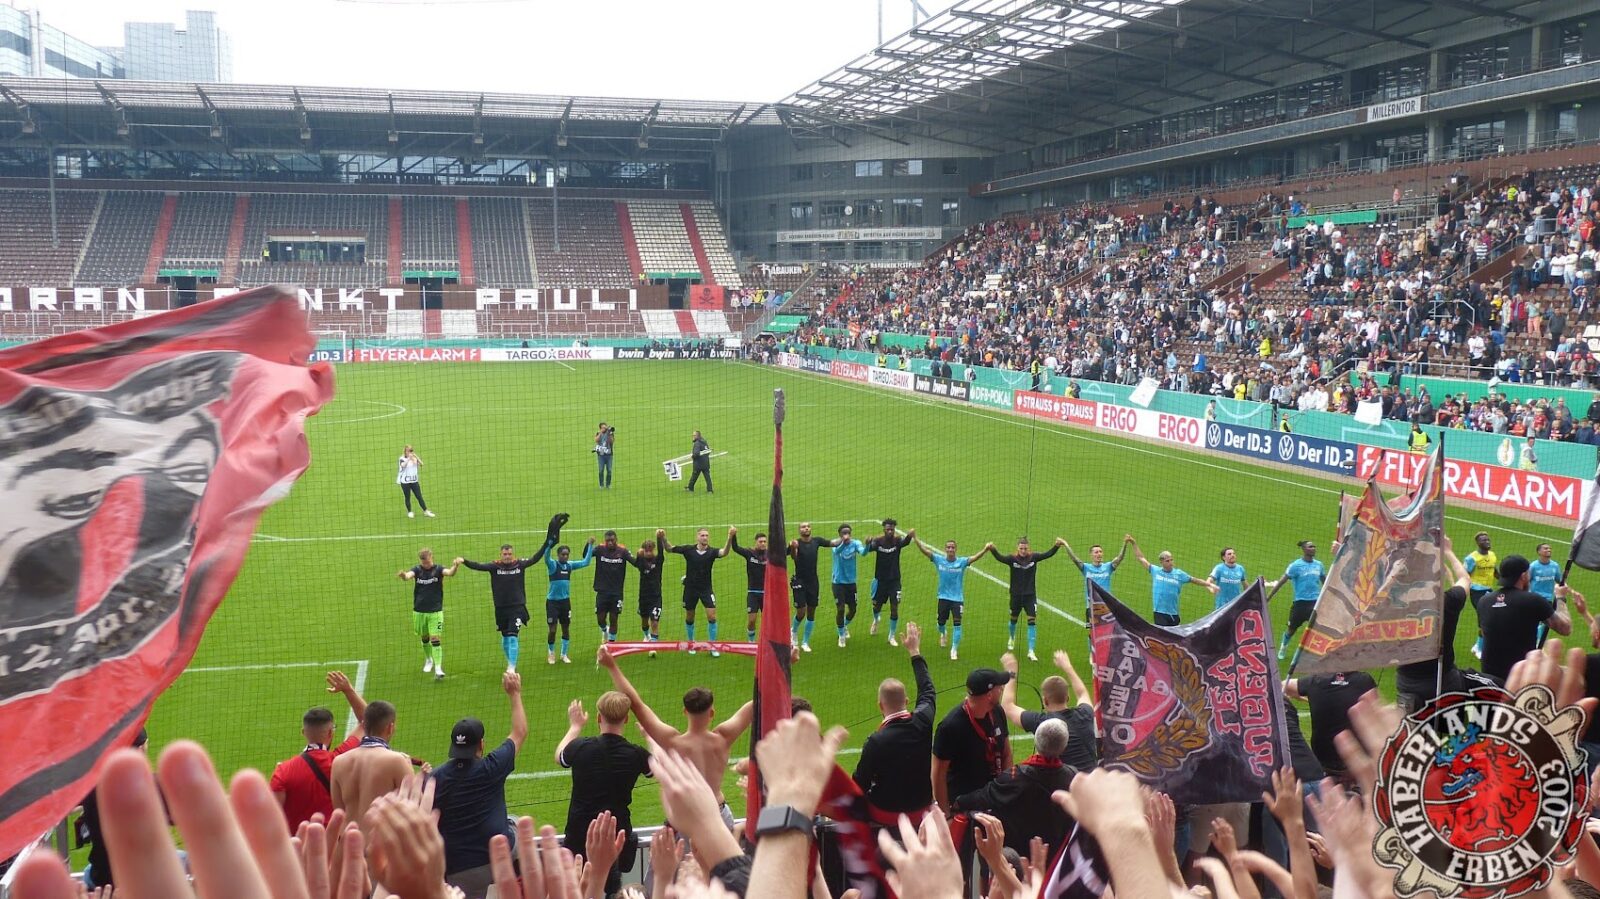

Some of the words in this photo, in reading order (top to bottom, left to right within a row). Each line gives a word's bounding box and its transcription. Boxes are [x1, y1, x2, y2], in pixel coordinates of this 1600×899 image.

[1372, 101, 1416, 120] MILLERNTOR
[476, 288, 637, 311] PAULI
[360, 349, 466, 362] FLYERALARM
[618, 348, 645, 359] bwin
[932, 380, 948, 395] bwin
[975, 386, 1012, 406] DFB-POKAL
[1022, 396, 1053, 412] STRAUSS
[1060, 401, 1094, 420] STRAUSS
[1101, 404, 1138, 433] ERGO
[1158, 414, 1200, 444] ERGO
[1224, 428, 1245, 448] Der
[1248, 432, 1272, 455] ID.3
[1298, 441, 1323, 464] Der
[1324, 444, 1354, 469] ID.3
[1384, 451, 1581, 516] FLYRALARM
